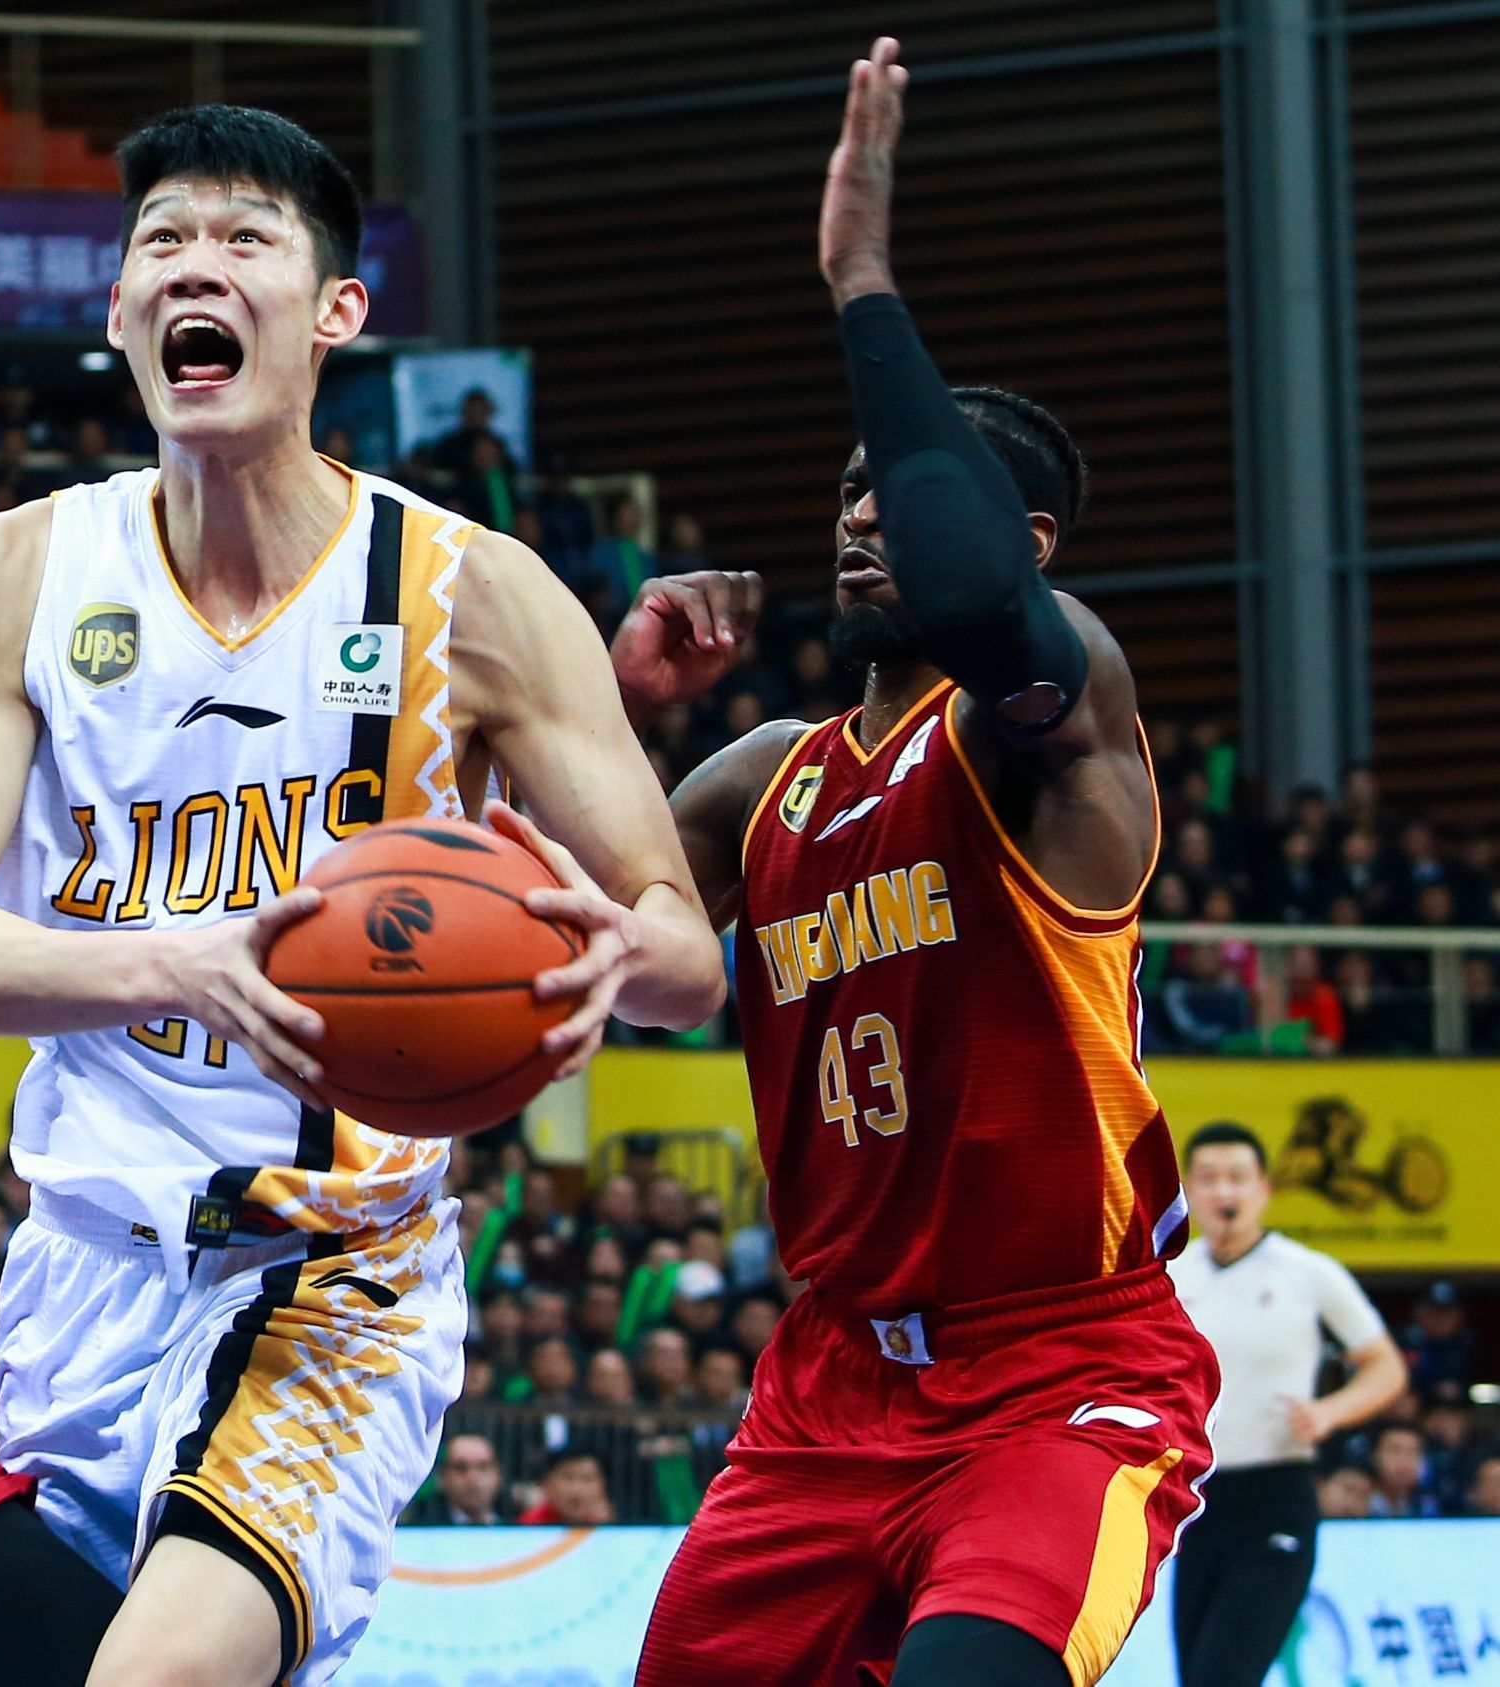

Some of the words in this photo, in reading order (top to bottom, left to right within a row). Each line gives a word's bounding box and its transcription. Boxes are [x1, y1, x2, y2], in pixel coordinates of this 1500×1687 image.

[73, 629, 135, 675] ups
[322, 695, 360, 704] CHINA
[364, 698, 390, 706] LIFE
[324, 680, 391, 696] 中国人寿
[51, 768, 383, 923] LIONS
[818, 1012, 908, 1148] 43
